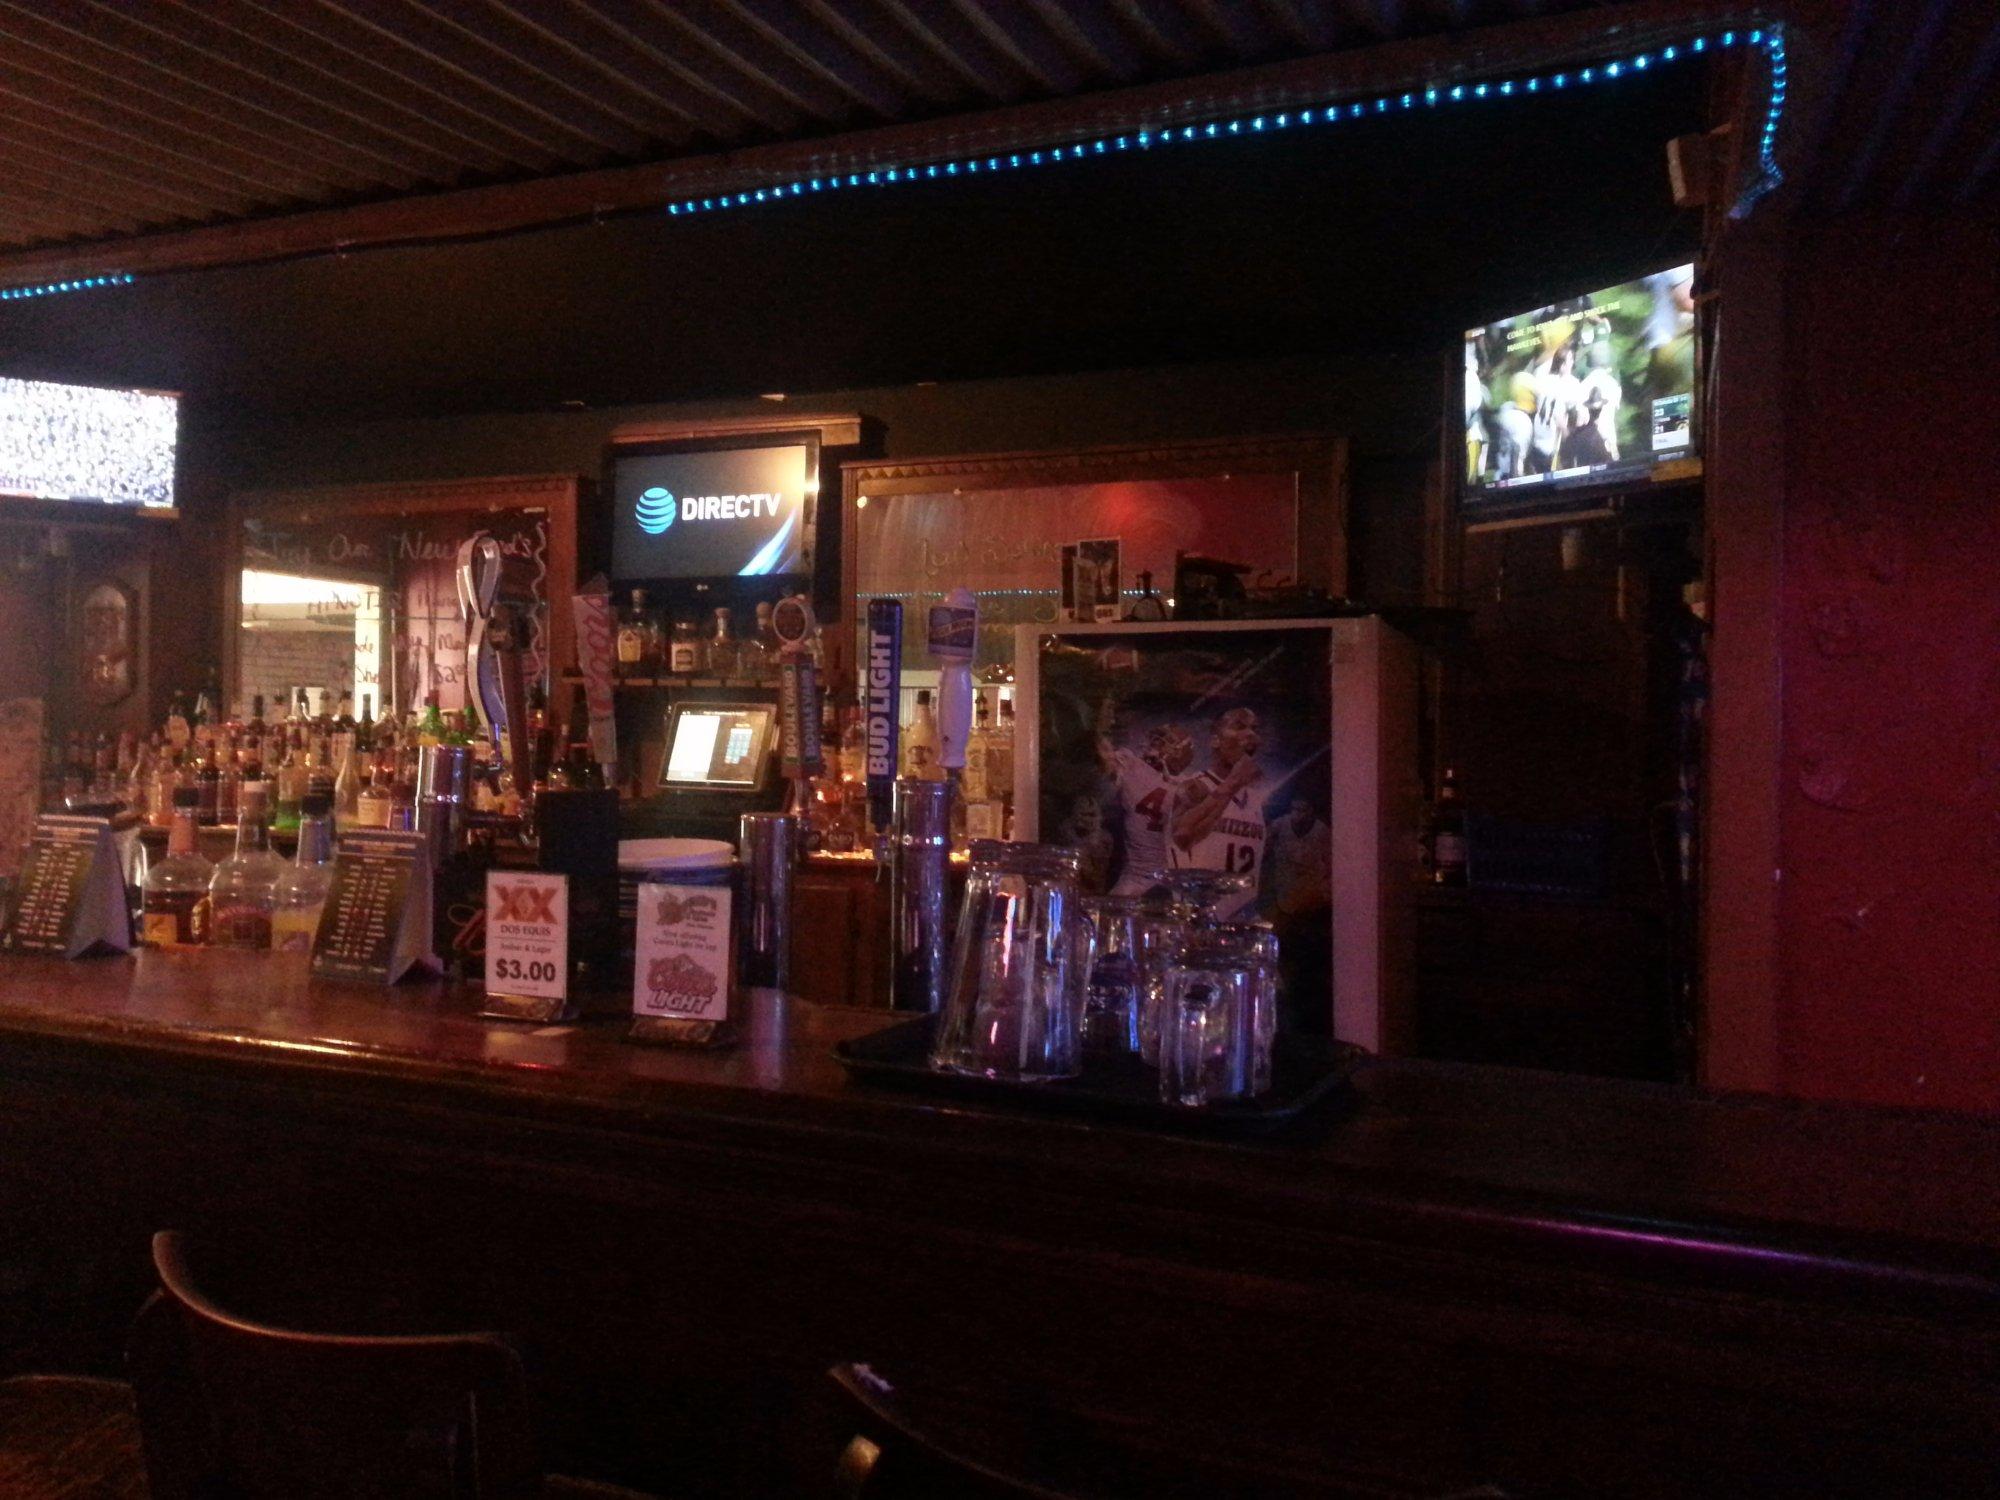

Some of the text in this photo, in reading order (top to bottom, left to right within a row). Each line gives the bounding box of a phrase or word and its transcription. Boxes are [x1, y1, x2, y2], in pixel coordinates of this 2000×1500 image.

[682, 493, 781, 520] DIRECTV
[783, 670, 798, 758] BOULEVARD
[869, 630, 892, 775] BUD LIGHT
[1135, 787, 1167, 832] 4
[1226, 843, 1255, 874] 12
[493, 884, 558, 925] XX
[500, 925, 551, 937] DOS EQUIS
[496, 958, 556, 982] $3.00
[647, 990, 713, 1014] LIGHT
